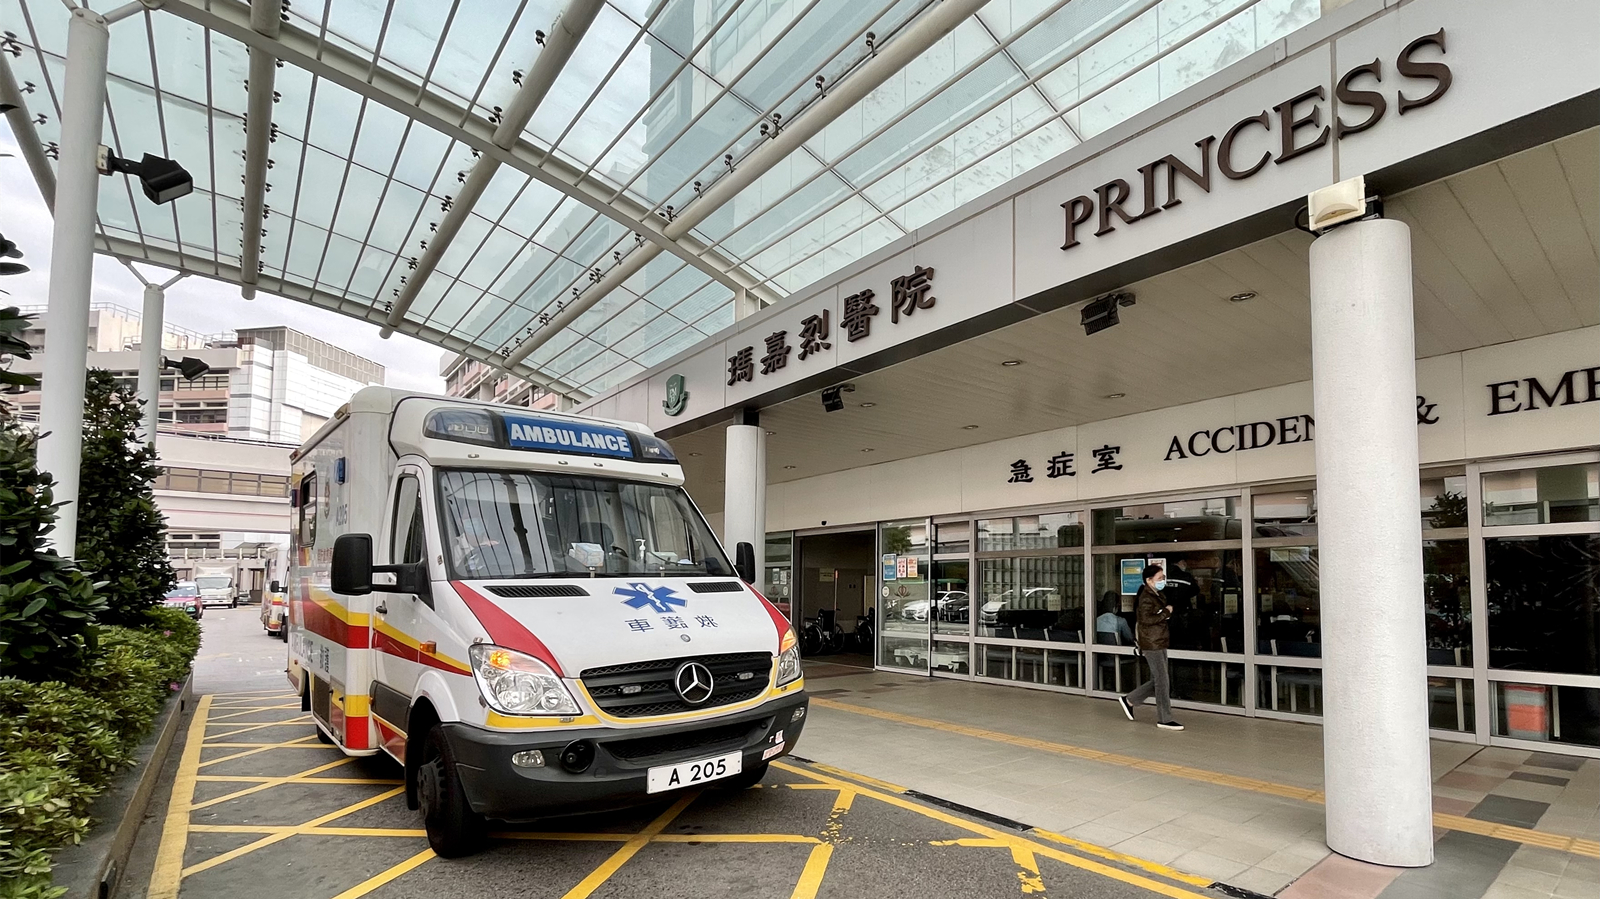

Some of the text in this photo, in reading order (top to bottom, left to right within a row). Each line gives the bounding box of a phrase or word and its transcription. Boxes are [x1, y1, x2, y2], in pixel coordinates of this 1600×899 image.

[1059, 26, 1453, 251] PRINCESS
[727, 265, 936, 387] 瑪嘉烈醫院
[510, 423, 630, 452] AMBULANCE
[1007, 444, 1124, 484] 急症室
[668, 758, 727, 787] A 205
